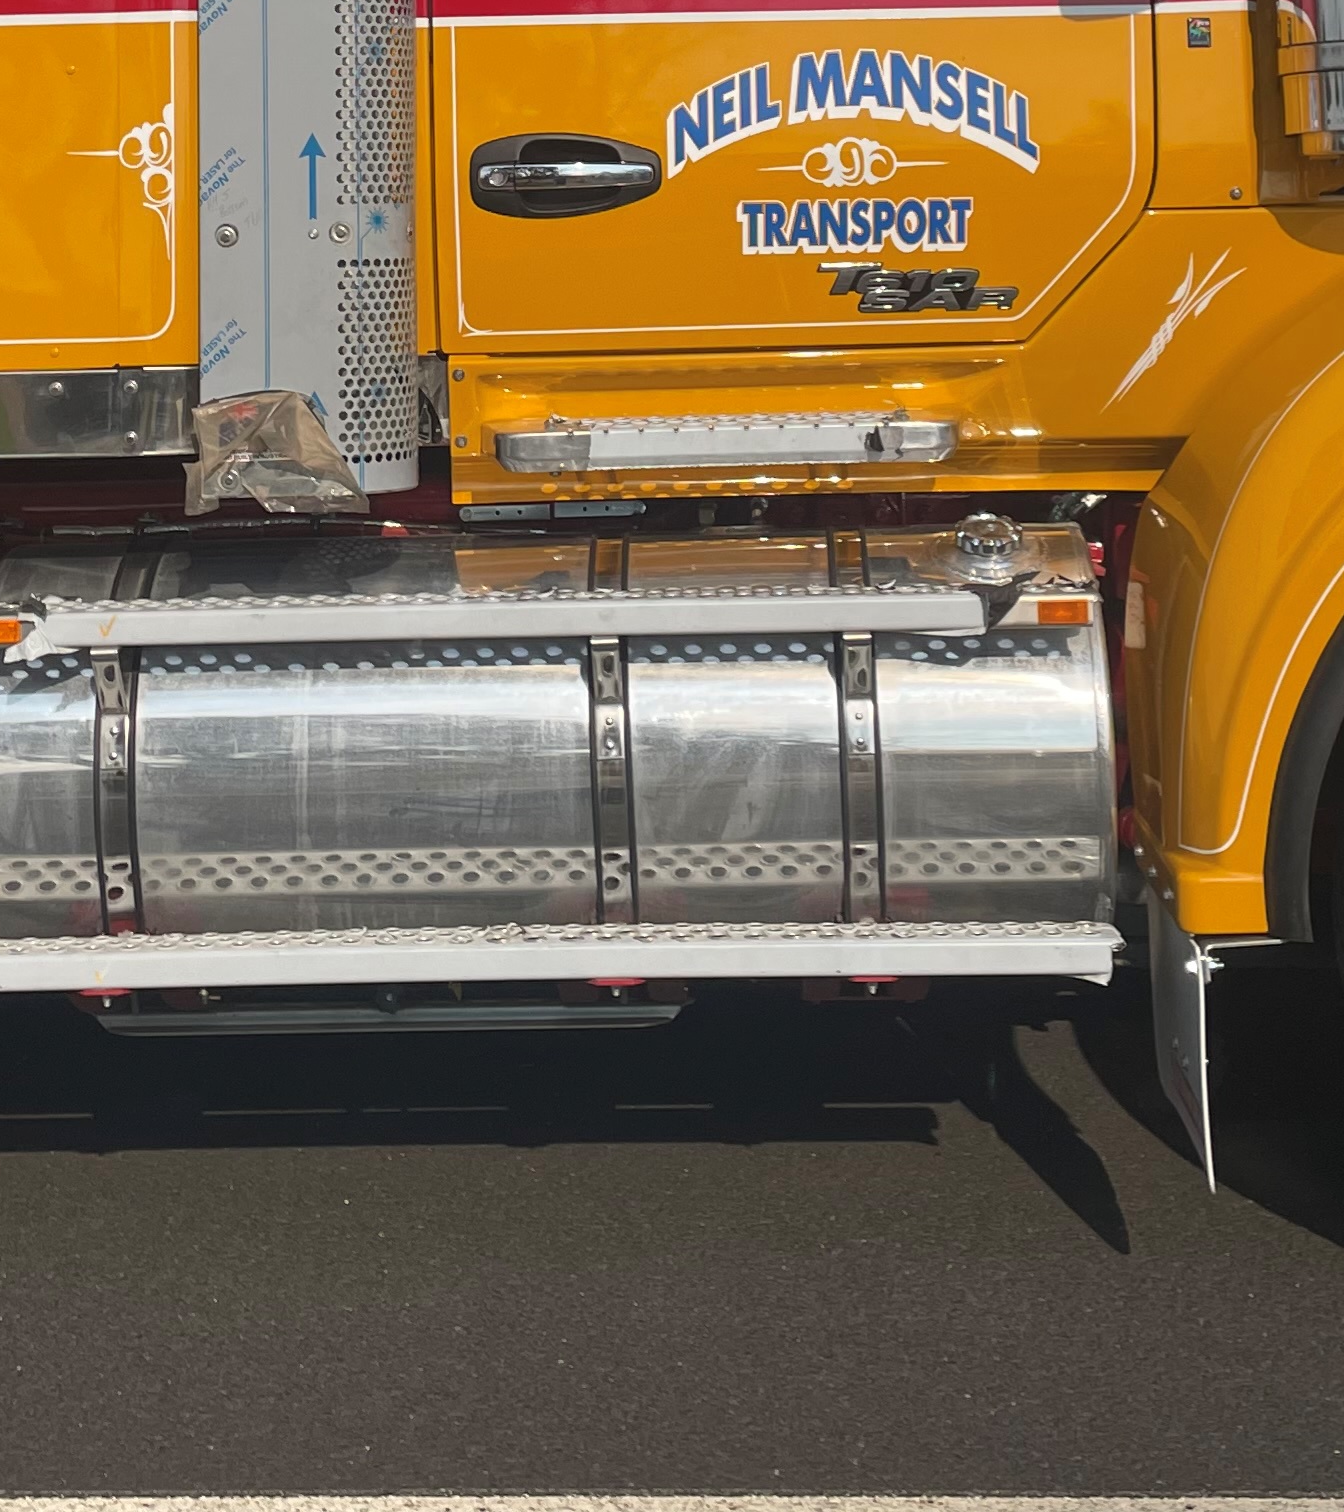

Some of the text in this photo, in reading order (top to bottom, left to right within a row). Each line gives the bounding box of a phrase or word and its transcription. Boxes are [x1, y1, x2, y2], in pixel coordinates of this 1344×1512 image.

[667, 48, 1040, 179] NEIL MANSELL
[224, 147, 236, 160] for
[227, 156, 246, 173] The
[200, 158, 226, 184] LASER
[736, 197, 973, 255] TRANSPORT
[817, 261, 979, 295] T610
[857, 286, 1020, 313] SAR
[202, 319, 238, 356] for LASER
[228, 329, 247, 345] The
